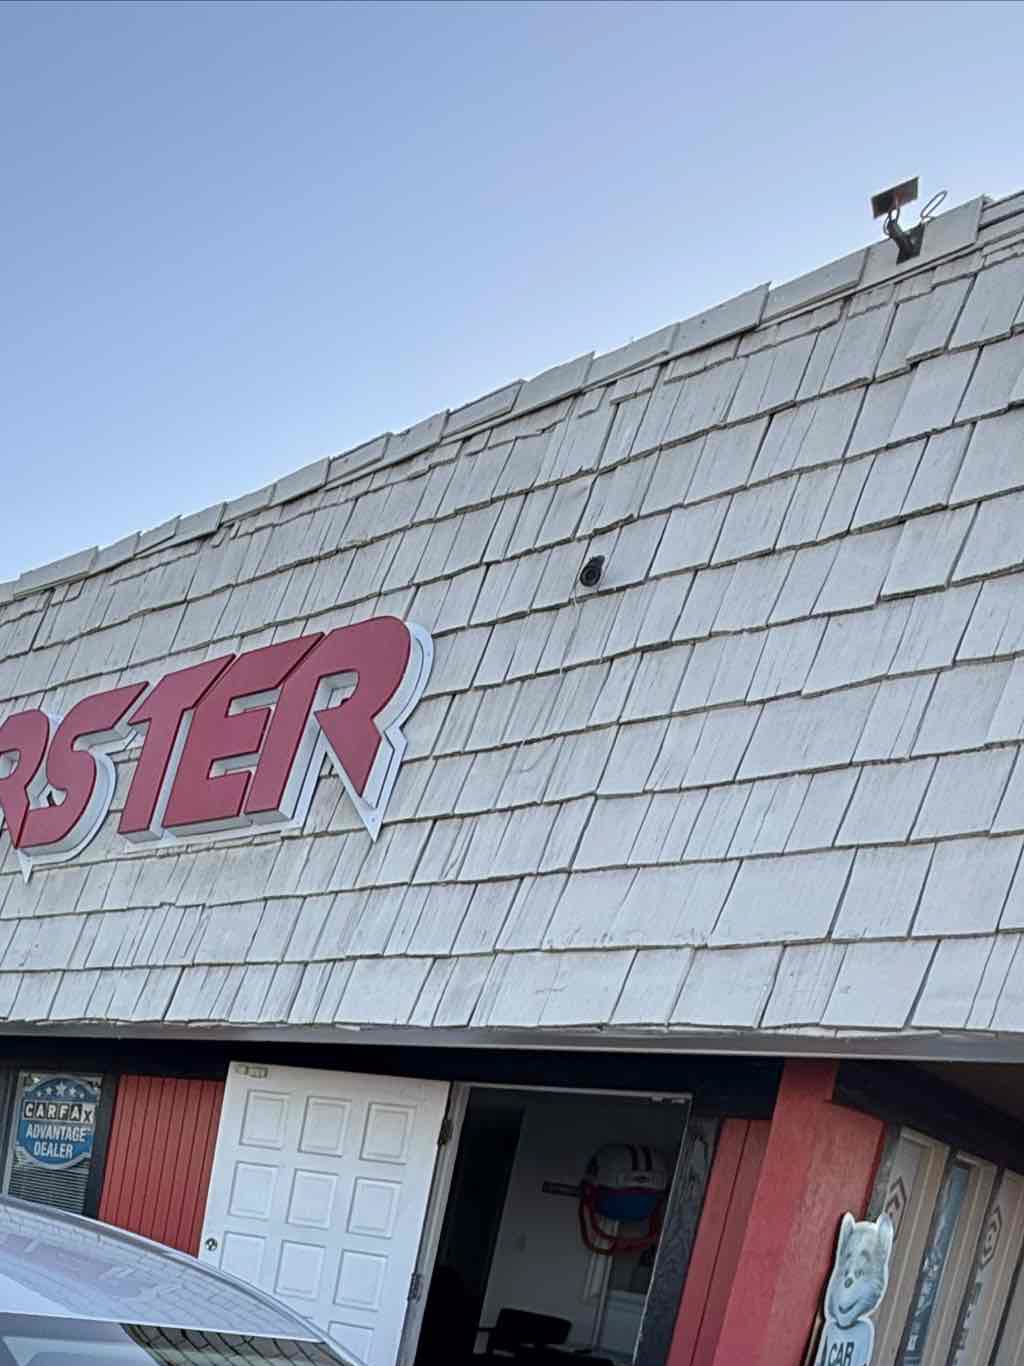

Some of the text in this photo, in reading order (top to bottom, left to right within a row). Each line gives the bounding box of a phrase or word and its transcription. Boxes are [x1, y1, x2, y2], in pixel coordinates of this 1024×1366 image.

[24, 1102, 94, 1123] CARFAX
[25, 1124, 86, 1142] ADVANTAGE
[33, 1141, 73, 1159] DEALER
